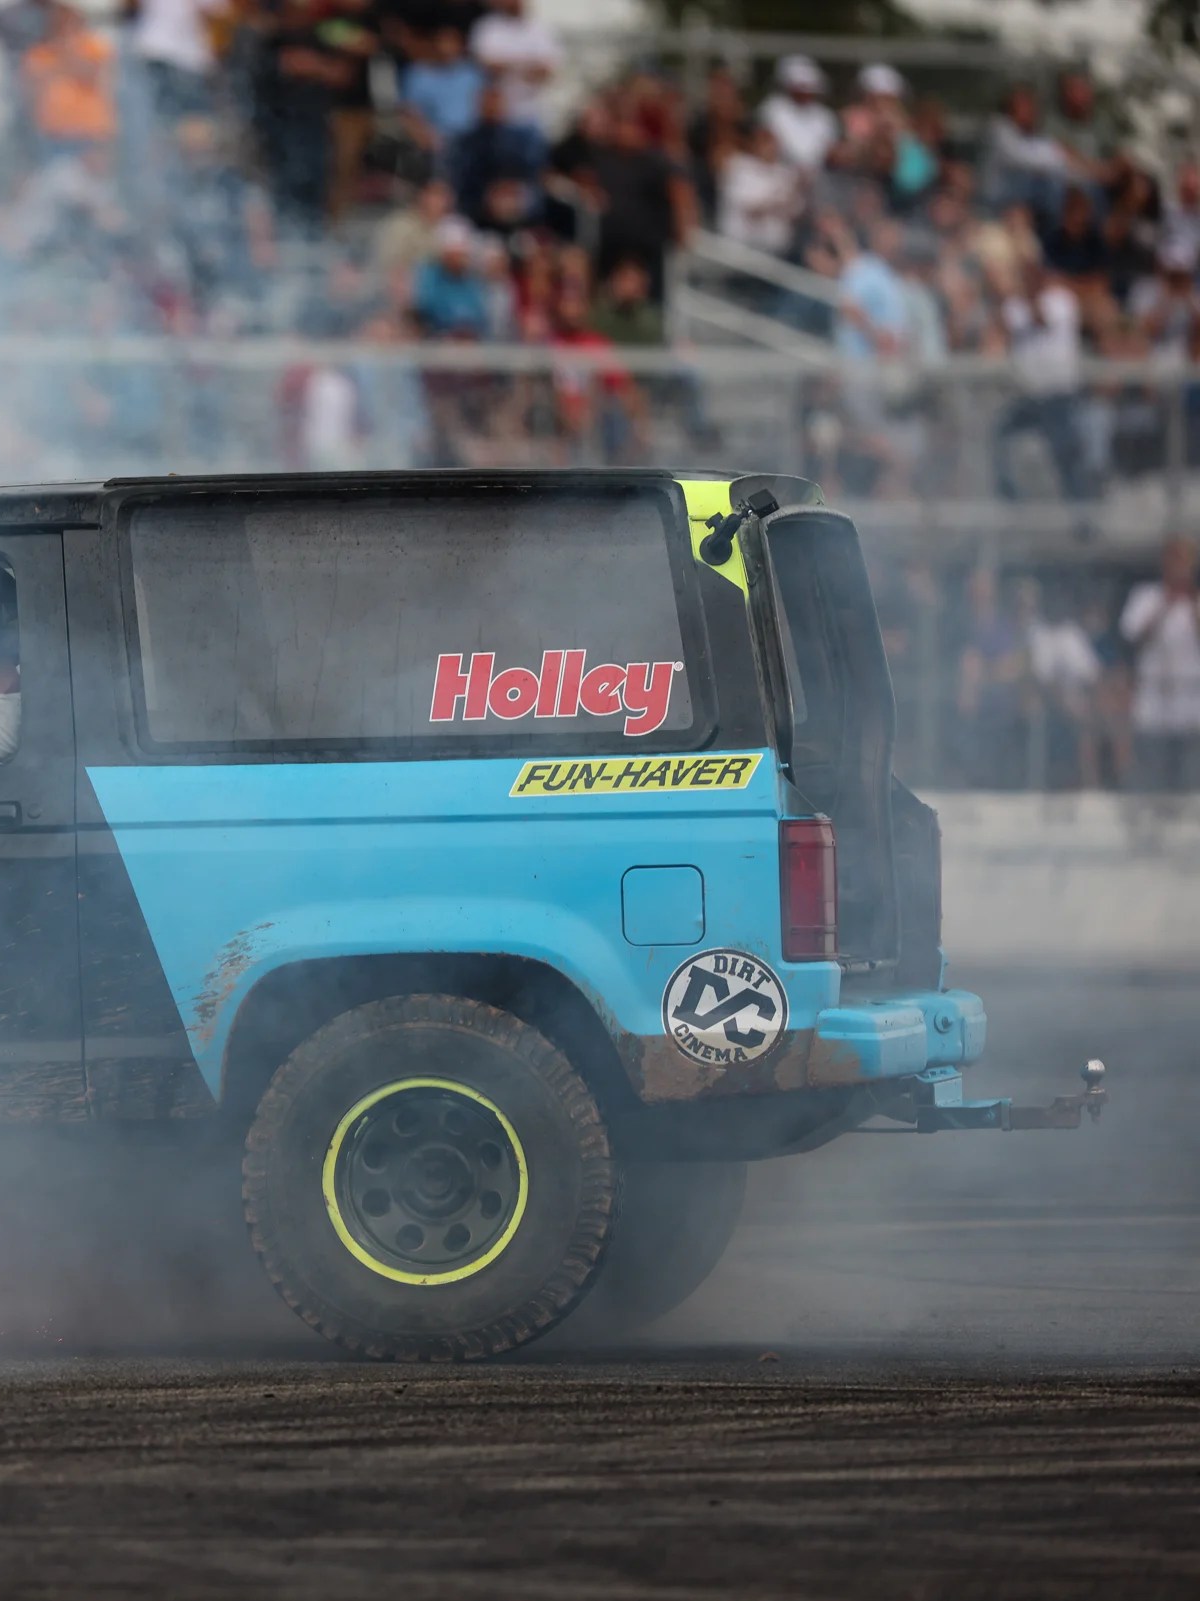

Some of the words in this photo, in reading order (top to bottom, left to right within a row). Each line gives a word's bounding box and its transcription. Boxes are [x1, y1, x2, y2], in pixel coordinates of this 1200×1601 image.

[429, 649, 675, 737] Holley
[516, 758, 752, 792] FUN-HAVER
[713, 955, 772, 990] DIRT
[671, 964, 777, 1049] DC
[674, 1023, 749, 1062] CINEMA
